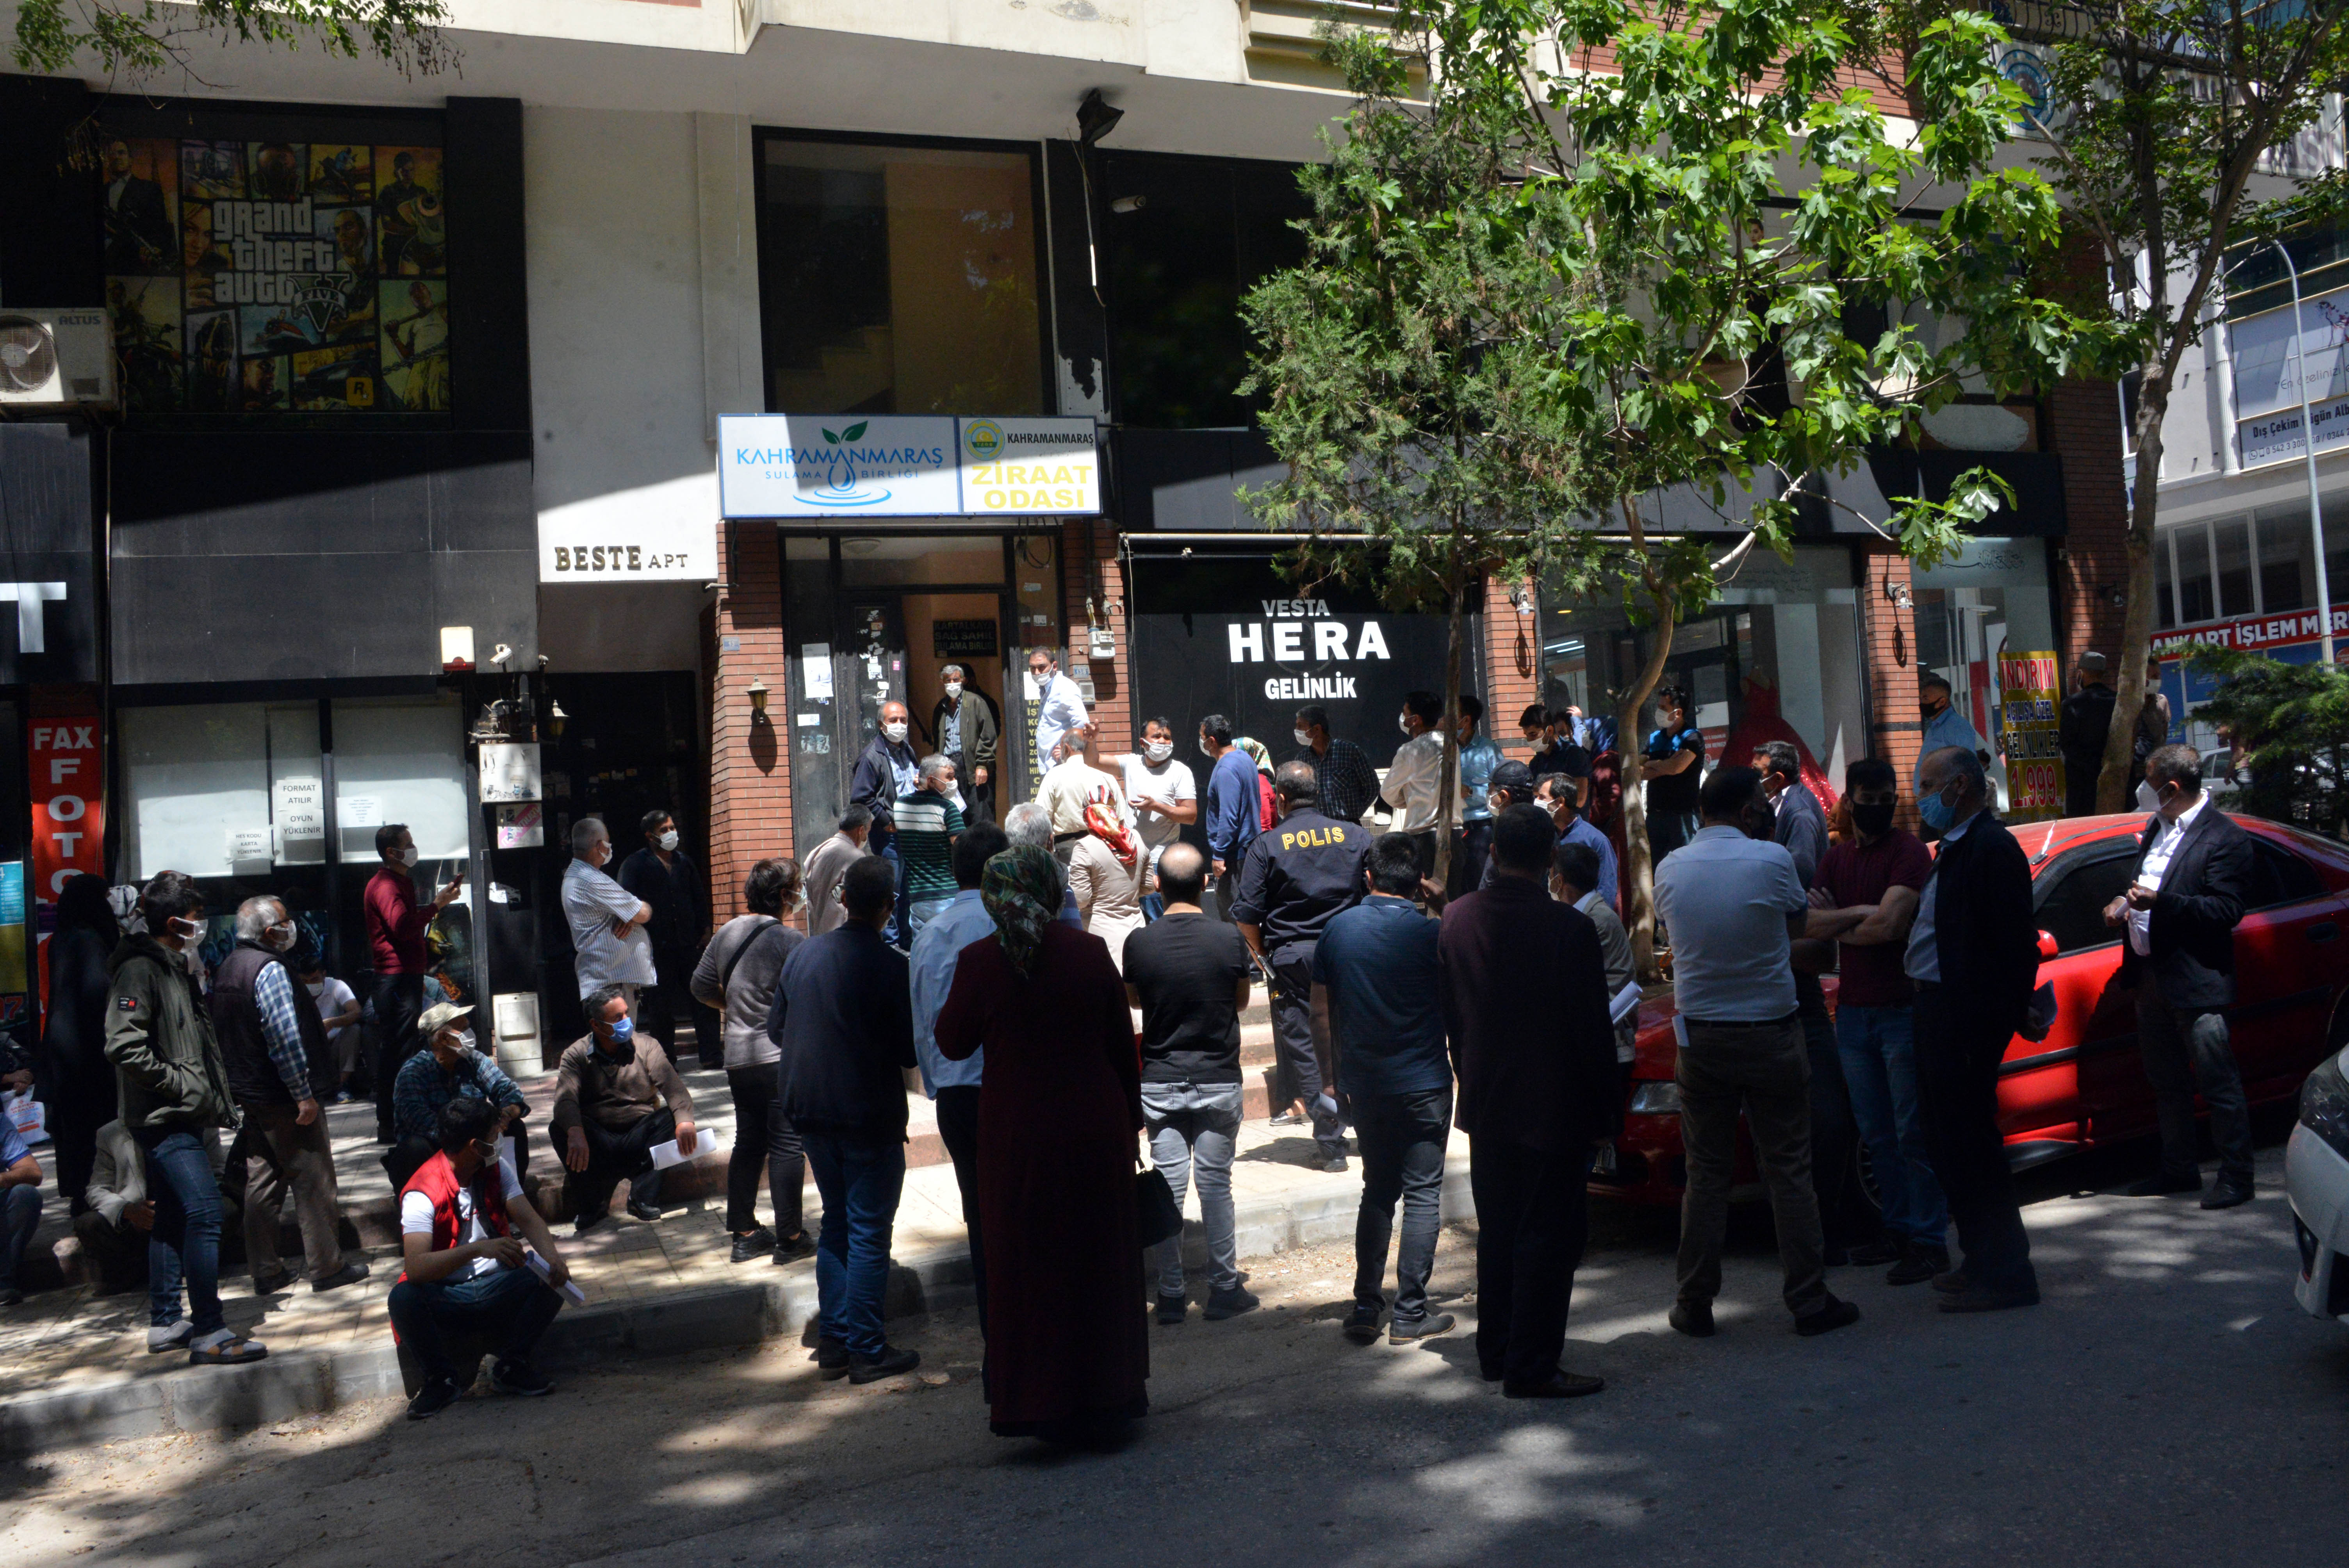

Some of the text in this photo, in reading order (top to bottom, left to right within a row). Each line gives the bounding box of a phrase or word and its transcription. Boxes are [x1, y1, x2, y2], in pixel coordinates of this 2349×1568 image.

[59, 315, 101, 325] ALTUS
[1007, 433, 1094, 447] KAHRAMANMARAŞ
[2253, 426, 2267, 438] Dış
[2270, 419, 2299, 436] Çekim
[2272, 444, 2284, 453] 542
[2327, 430, 2344, 440] 0344
[737, 448, 943, 469] KAHRAMANMARAŞ
[765, 467, 918, 479] SULAMA BİRLİĞİ
[971, 461, 1092, 485] ZİRAAT
[984, 489, 1084, 509] ODASI
[554, 545, 688, 572] BESTE APT
[1261, 599, 1330, 617] VESTA
[935, 641, 968, 650] SULAMA
[1228, 622, 1391, 663] HERA
[2149, 628, 2231, 655] ANKART
[2235, 618, 2297, 647] İŞLEM
[1265, 671, 1357, 700] GELİNLİK
[2035, 695, 2055, 721] ÖZEL
[34, 727, 94, 750] FAX
[2012, 764, 2057, 808] 1.999
[1281, 827, 1345, 850] POLİS
